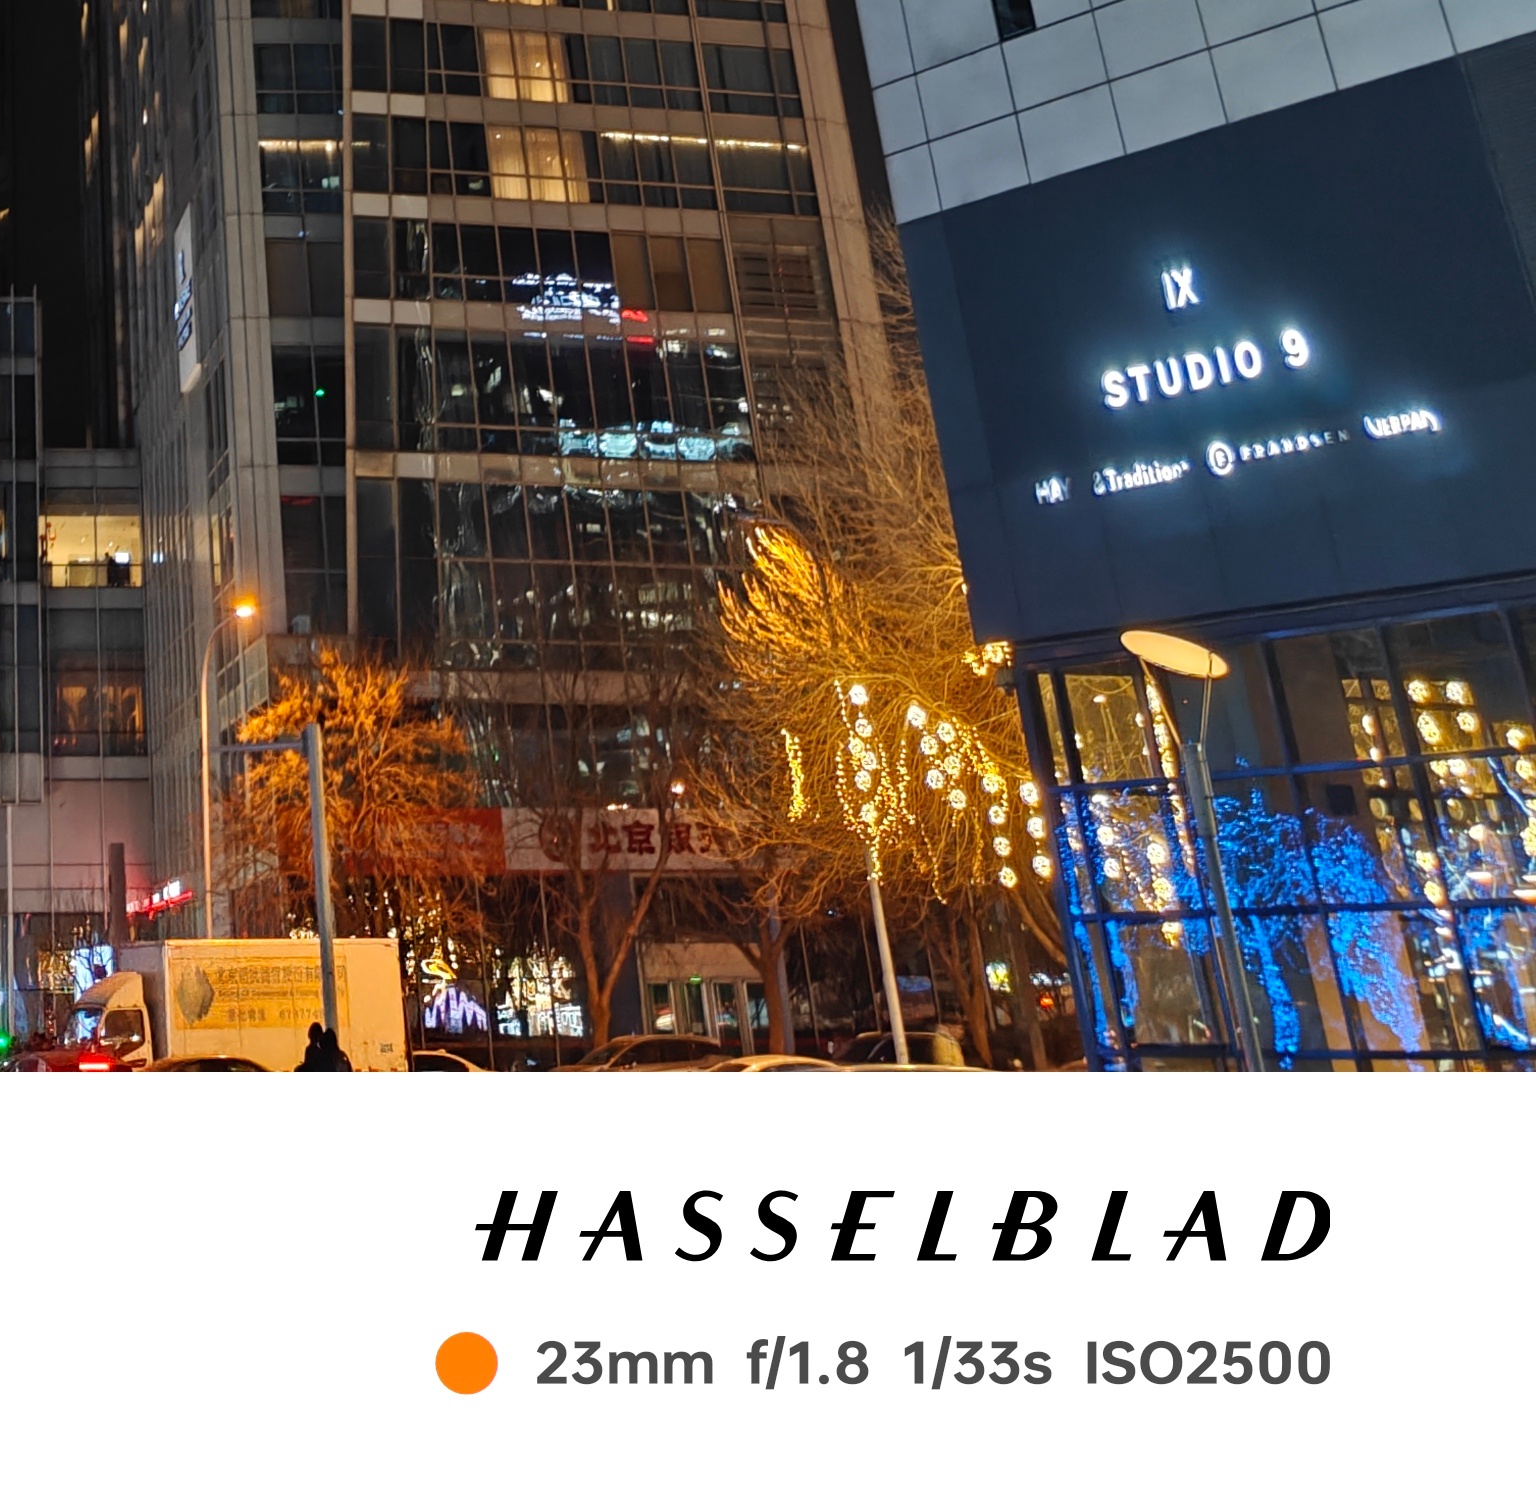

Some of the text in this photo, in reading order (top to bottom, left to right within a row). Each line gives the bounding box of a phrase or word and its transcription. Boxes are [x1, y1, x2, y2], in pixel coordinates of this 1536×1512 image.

[1161, 267, 1200, 311] IX
[1101, 328, 1310, 409] STUDIO 9
[1035, 475, 1071, 505] HAY
[1239, 429, 1351, 462] FRANDSEN
[1363, 409, 1441, 439] VERPAN
